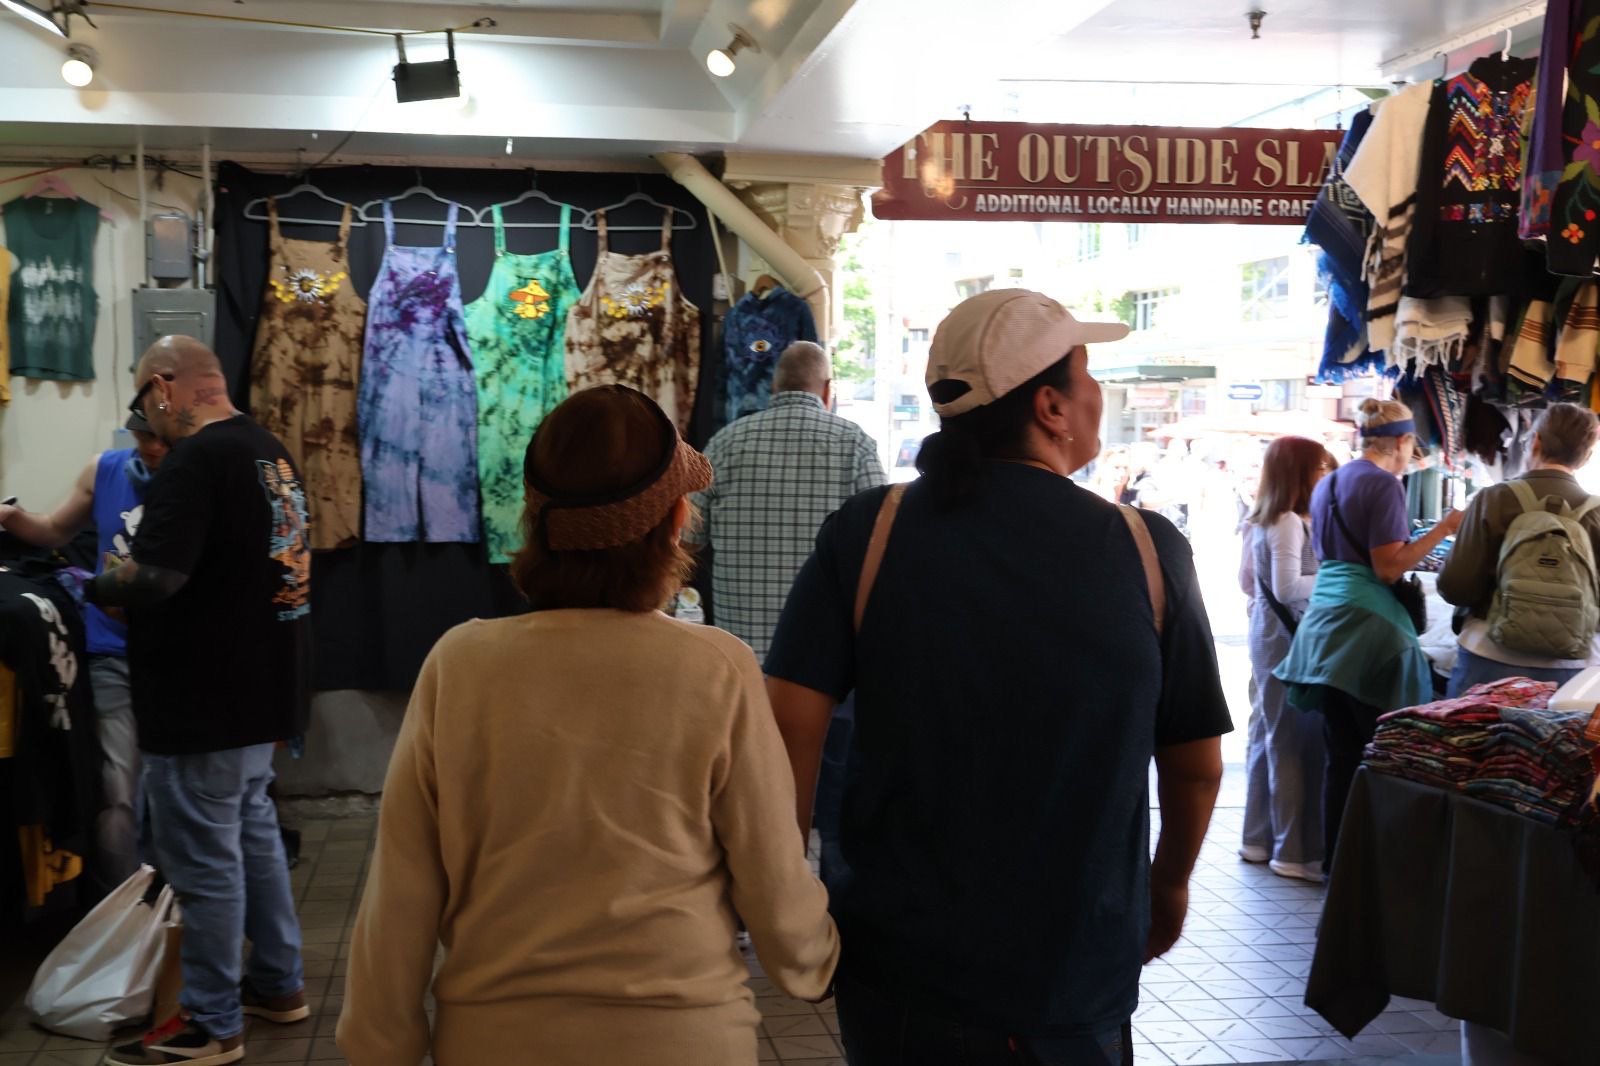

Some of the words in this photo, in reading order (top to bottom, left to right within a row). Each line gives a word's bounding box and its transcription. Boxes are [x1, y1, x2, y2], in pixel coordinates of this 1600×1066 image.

[902, 131, 1000, 183] THE
[1018, 132, 1239, 194] OUTSIDE
[975, 193, 1083, 214] ADDITIONAL
[1087, 195, 1162, 215] LOCALLY
[1166, 197, 1263, 217] HANDMADE
[1267, 198, 1316, 217] CRAF
